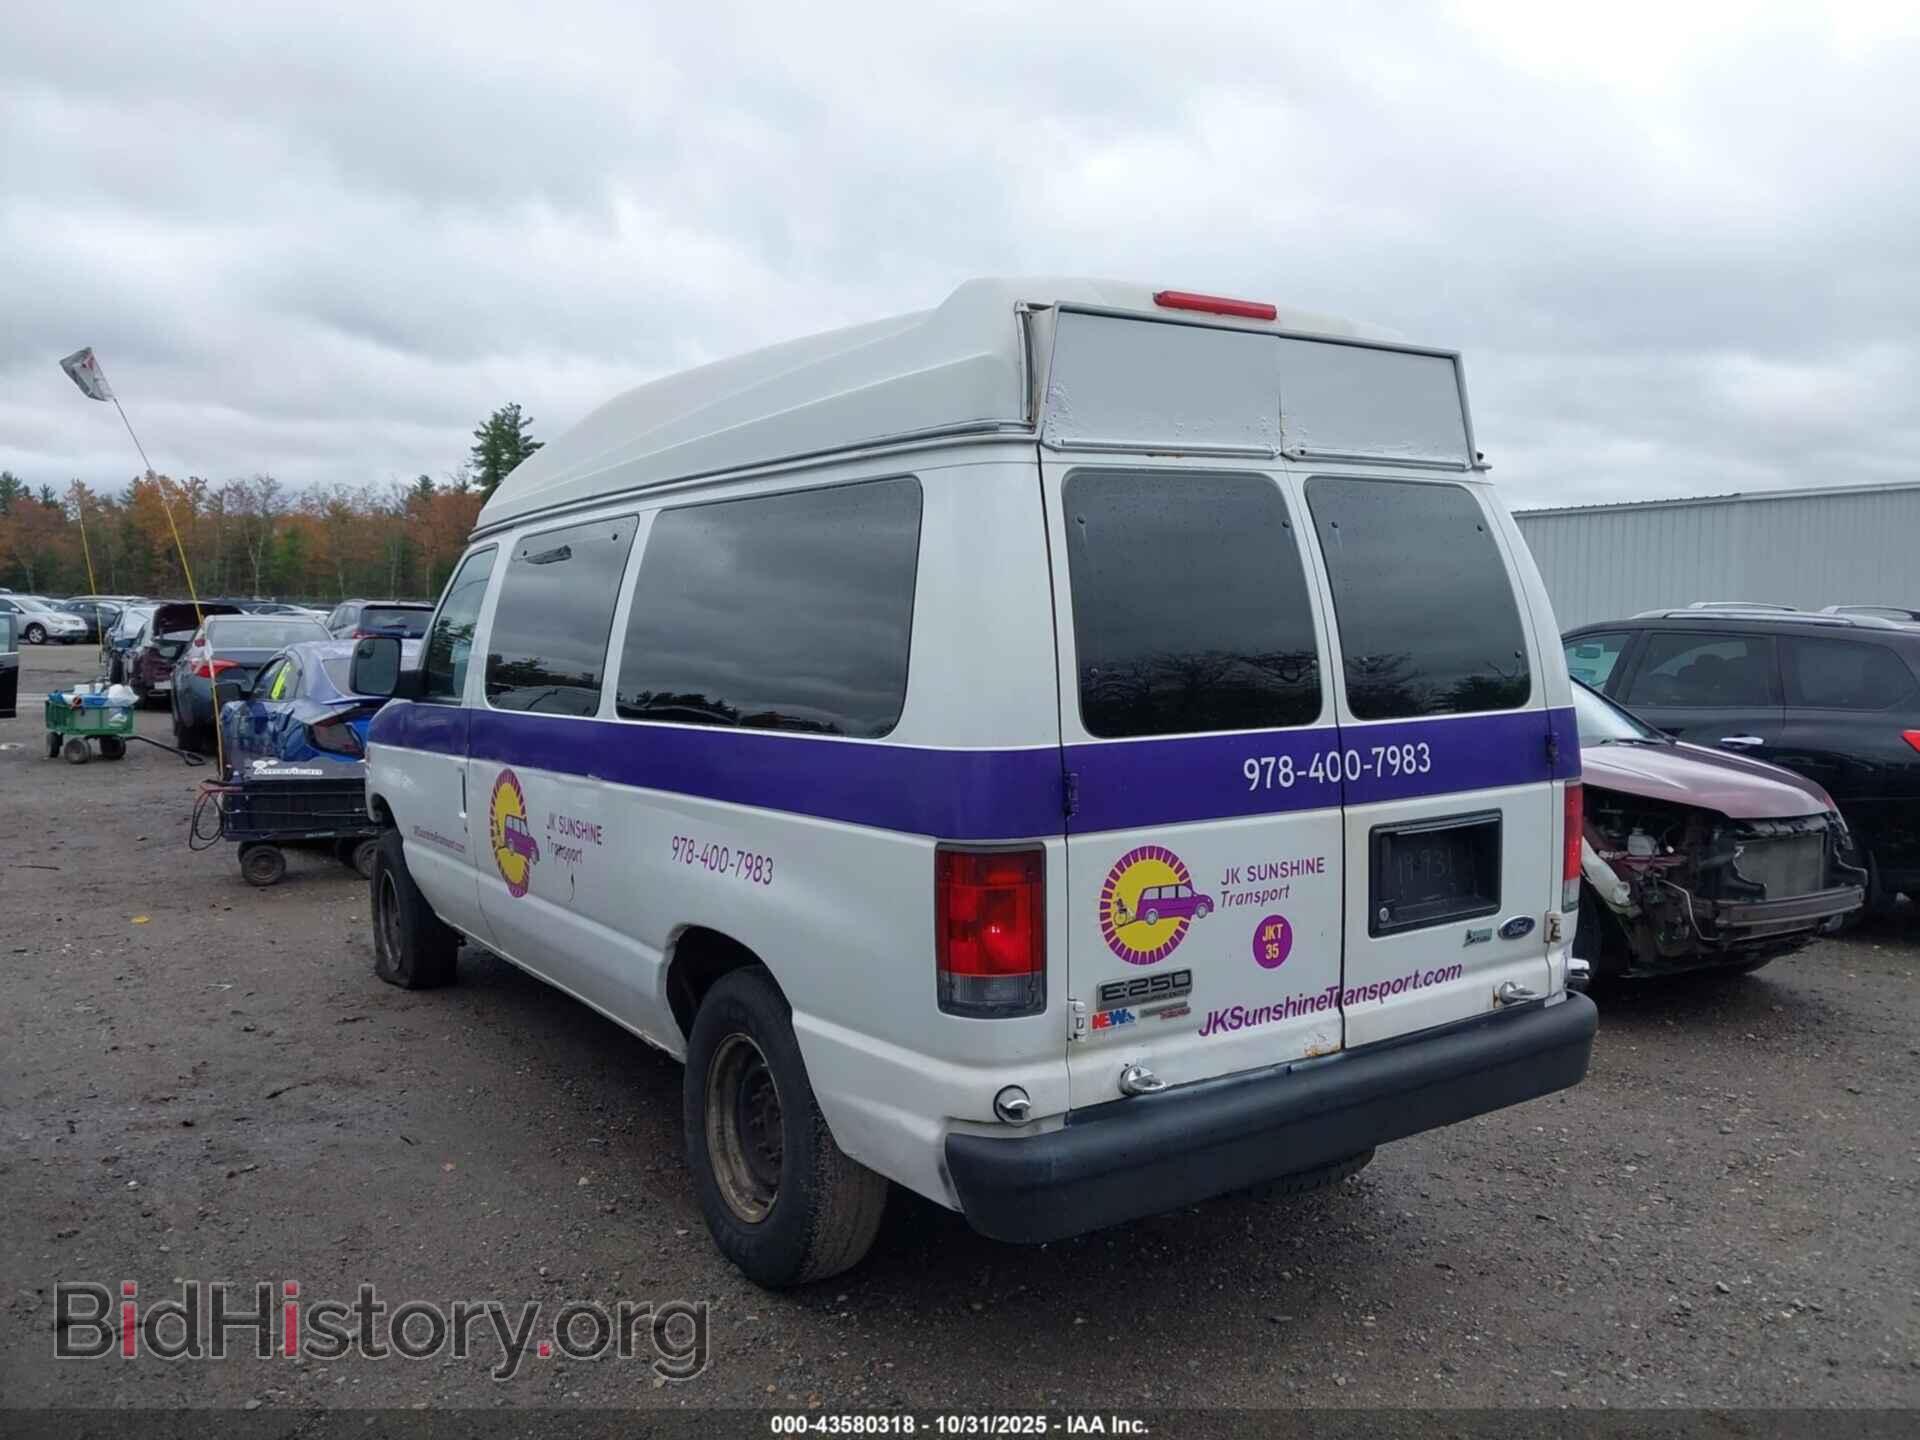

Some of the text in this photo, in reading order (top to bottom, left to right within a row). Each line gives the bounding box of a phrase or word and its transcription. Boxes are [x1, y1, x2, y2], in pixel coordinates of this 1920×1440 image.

[1243, 742, 1431, 791] 978-400-7983
[559, 815, 603, 845] SUNSHINE
[547, 836, 583, 867] Transport
[671, 836, 774, 885] 978-400-7983
[1220, 857, 1325, 886] JK SUNSHINE
[1220, 884, 1290, 908] Transport
[1262, 923, 1284, 942] JKT
[1265, 943, 1280, 960] 35
[1198, 963, 1462, 1036] JKSunshineTransport.com
